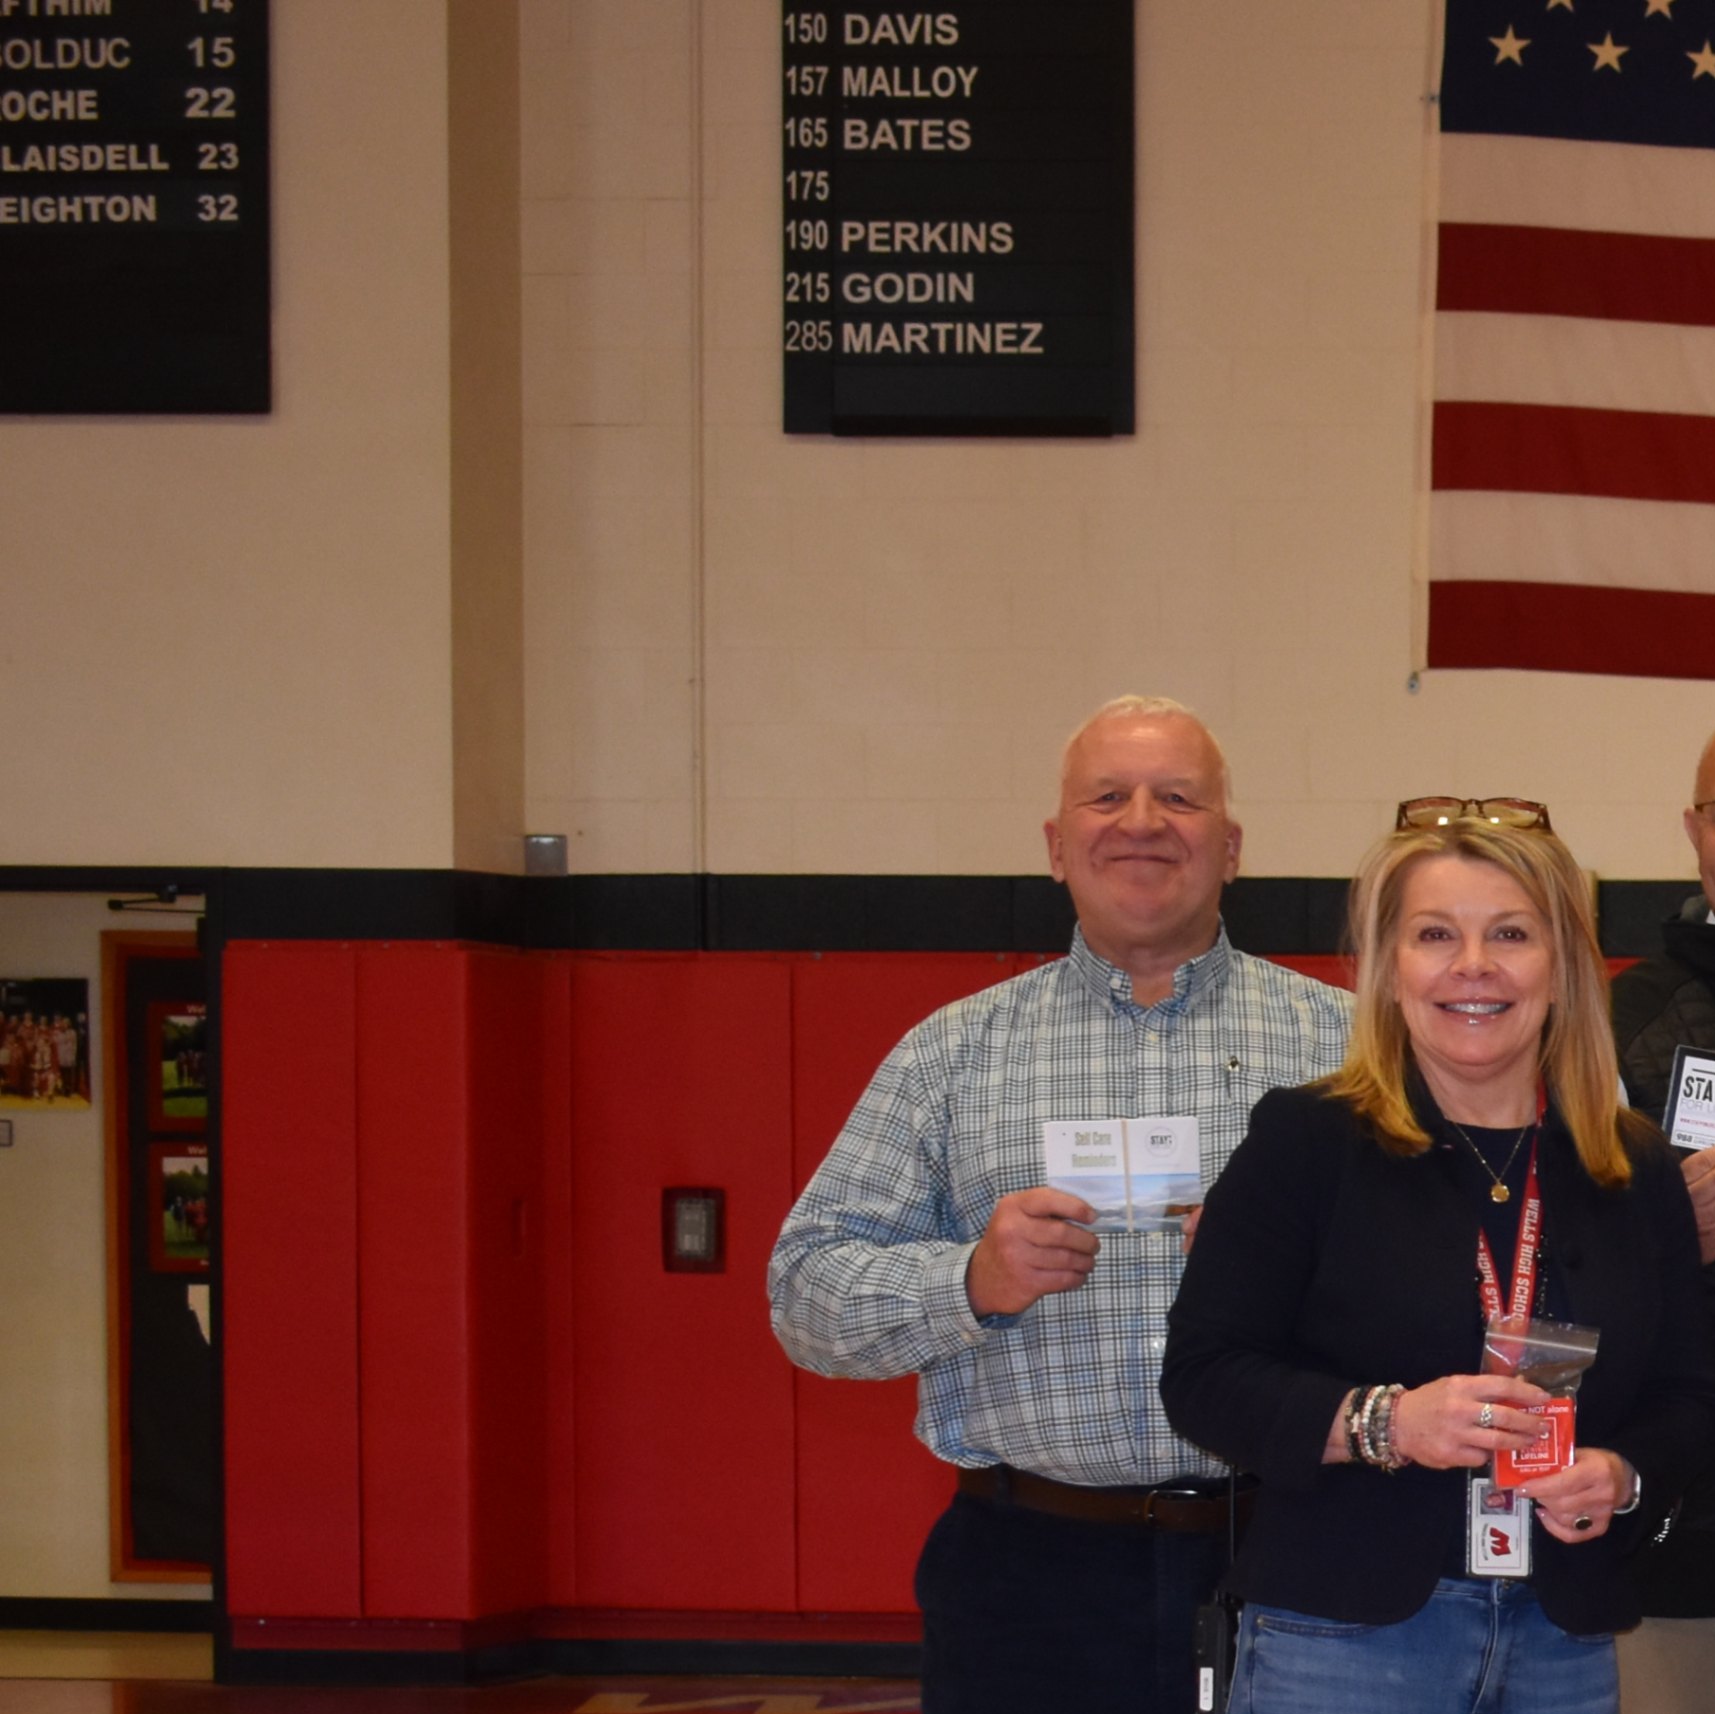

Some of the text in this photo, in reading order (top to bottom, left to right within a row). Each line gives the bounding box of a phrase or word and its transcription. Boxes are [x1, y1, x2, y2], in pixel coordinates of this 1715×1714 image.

[785, 14, 959, 46] 150 DAVIS
[187, 36, 236, 68] 15
[785, 66, 979, 98] 157 MALLOY
[184, 87, 236, 118] 22
[785, 118, 972, 151] 165 BATES
[198, 143, 240, 170] 23
[785, 171, 829, 201] 175
[198, 194, 239, 222] 32
[785, 221, 1014, 254] 190 PERKINS
[785, 272, 975, 304] 215 GODIN
[785, 322, 1044, 354] 285 MARTINEZ
[1522, 1199, 1541, 1242] WELLS
[1516, 1244, 1535, 1275] HIGH
